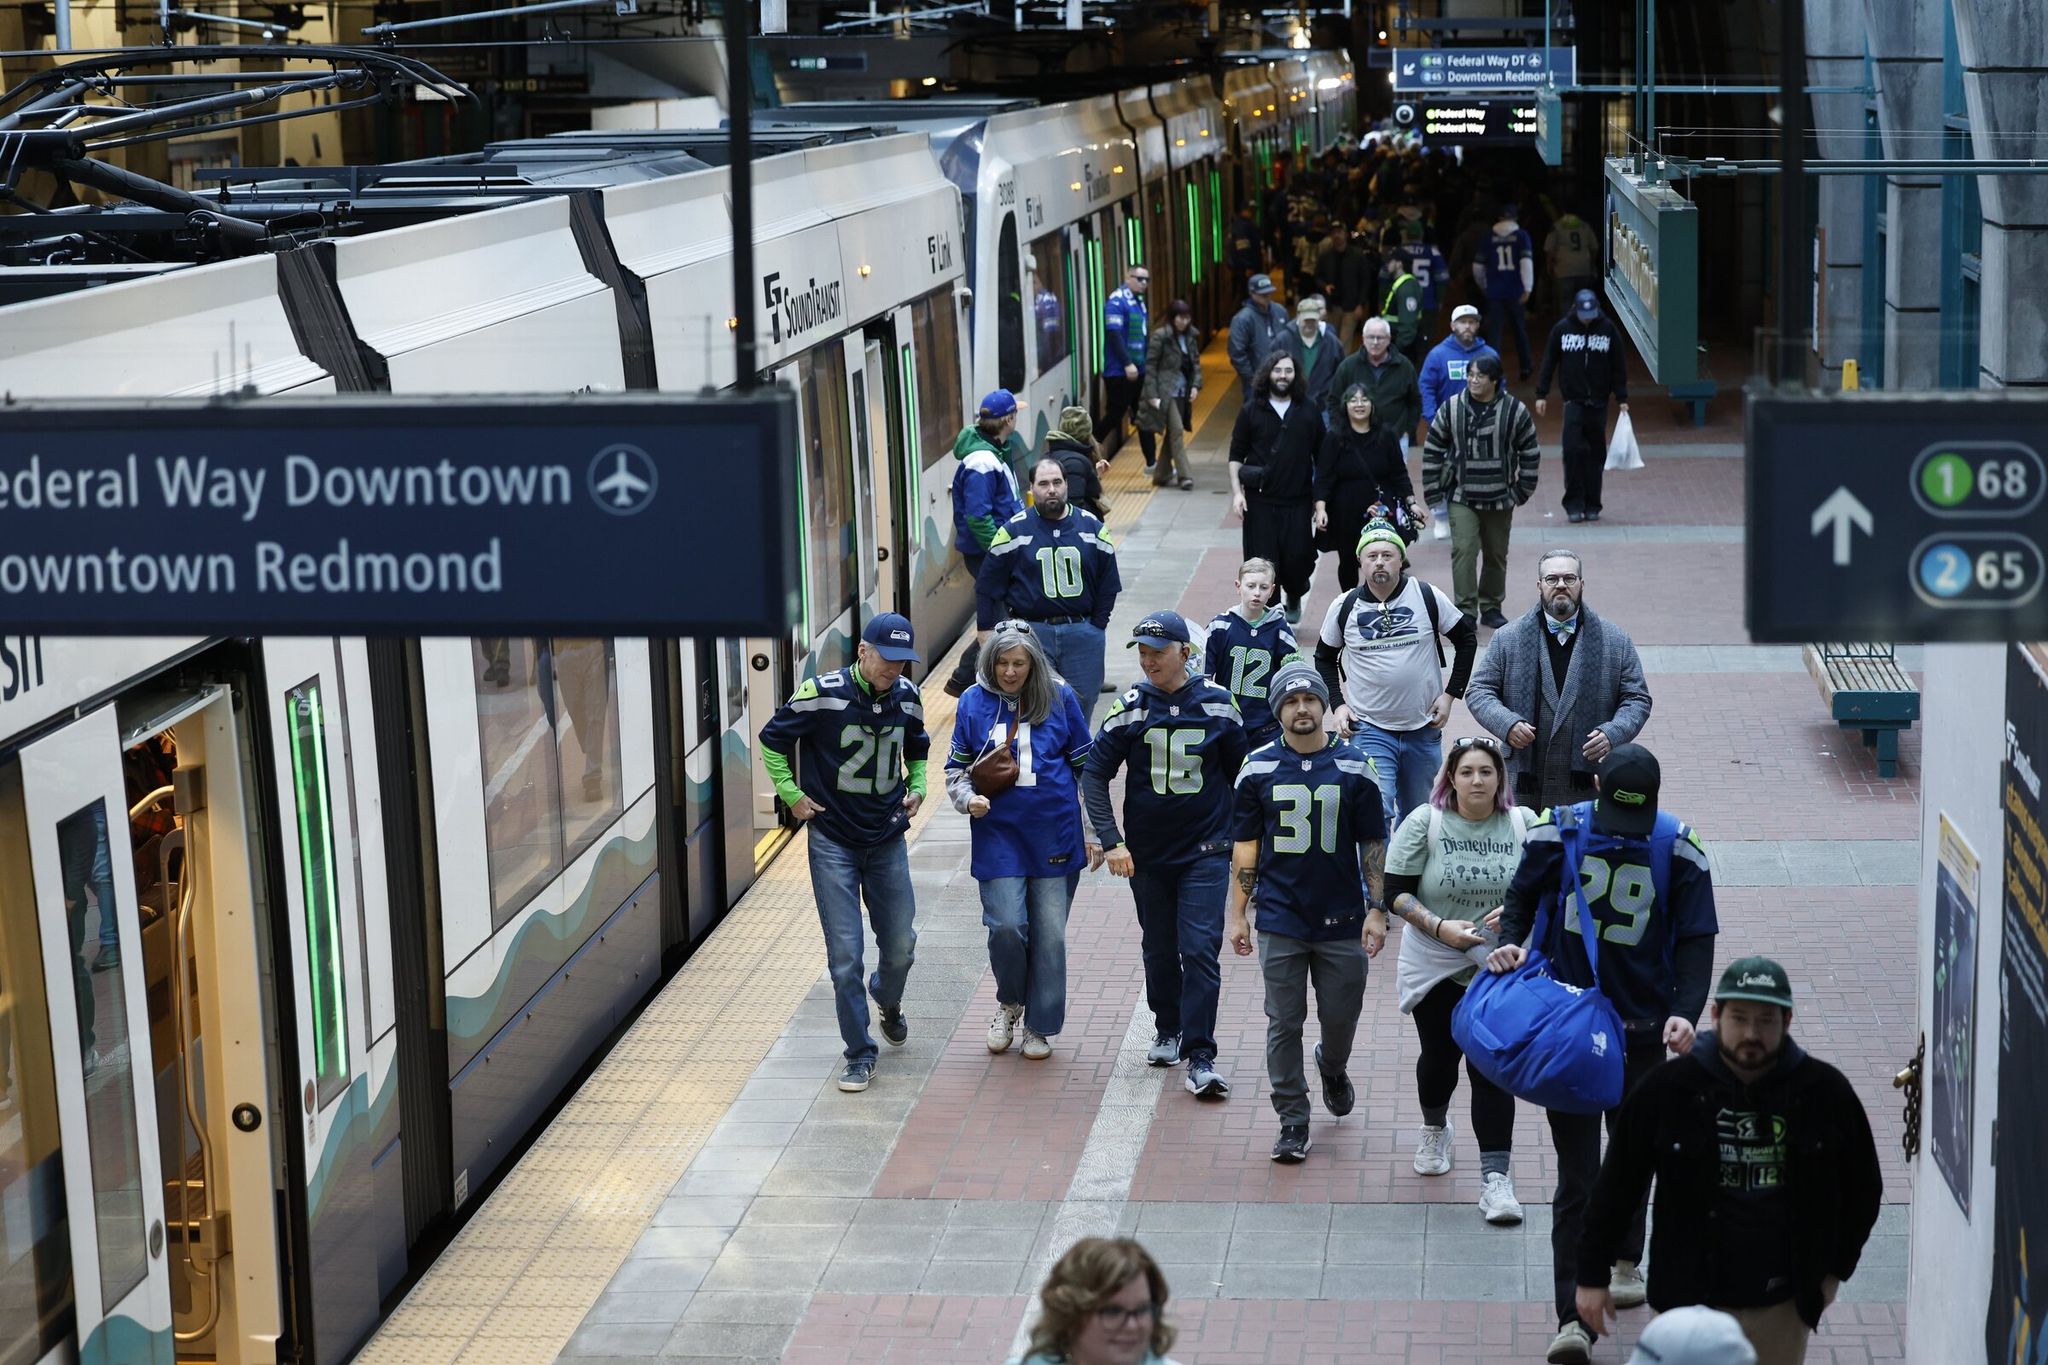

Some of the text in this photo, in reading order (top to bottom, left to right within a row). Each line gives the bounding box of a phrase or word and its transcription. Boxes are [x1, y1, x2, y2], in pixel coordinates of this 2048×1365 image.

[1447, 54, 1485, 67] Federal
[1487, 55, 1510, 69] Way
[1511, 55, 1526, 67] DT
[1447, 71, 1504, 83] Downtown
[1466, 109, 1485, 121] Way
[1466, 123, 1485, 135] Way
[937, 231, 953, 271] Link
[1496, 244, 1516, 271] 11
[1570, 231, 1582, 252] 9
[1412, 258, 1432, 288] 5
[157, 457, 266, 522] Way
[285, 454, 572, 507] Downtown
[1935, 460, 2028, 500] 1 68
[256, 538, 503, 594] Redmond
[1036, 546, 1084, 599] 10
[1934, 551, 2026, 590] 2 65
[1229, 645, 1272, 699] 12
[837, 724, 906, 796] 20
[1144, 727, 1206, 795] 16
[1272, 784, 1341, 854] 31
[1439, 837, 1514, 856] Disneyland
[1448, 893, 1470, 907] PLACE
[1564, 855, 1656, 947] 29
[1759, 1167, 1778, 1185] 12
